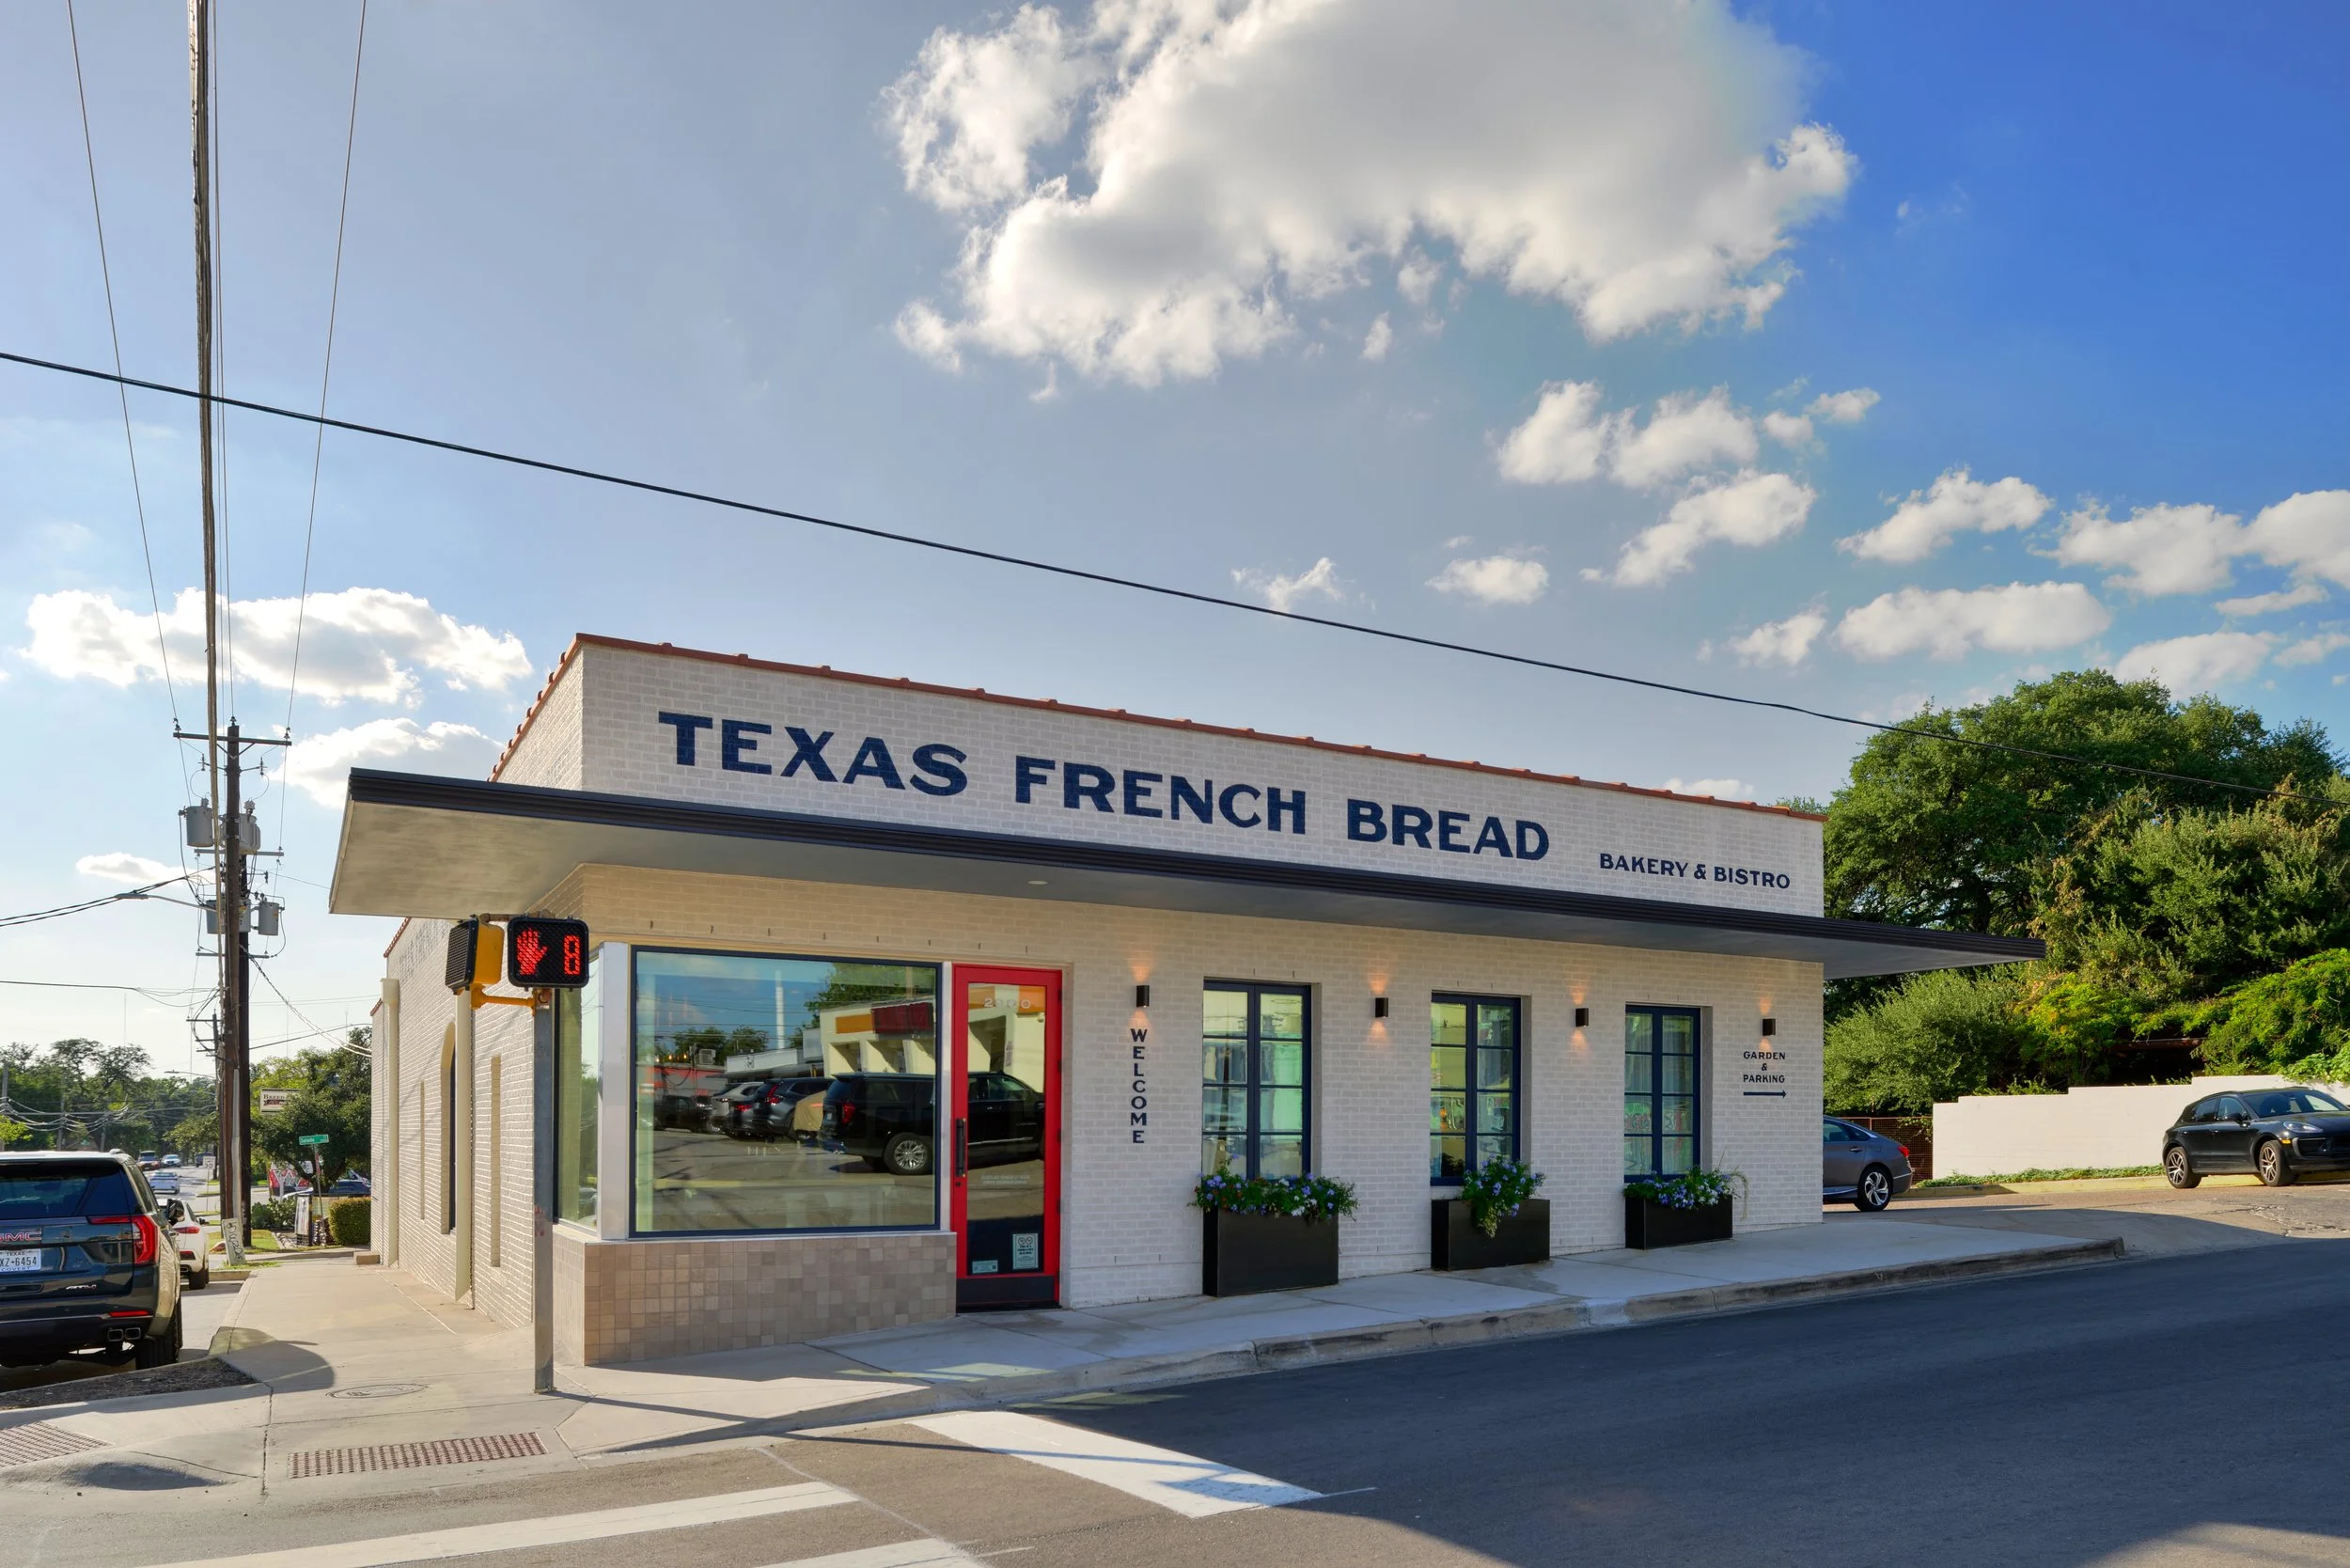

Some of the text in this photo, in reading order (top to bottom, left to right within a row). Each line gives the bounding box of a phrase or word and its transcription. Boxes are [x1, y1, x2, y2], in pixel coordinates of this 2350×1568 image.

[658, 711, 1550, 861] TEXAS FRENCH BREAD
[1599, 853, 1791, 889] BAKERY & BISTRO
[564, 934, 581, 976] 8
[1743, 1051, 1786, 1060] GARDEN
[1761, 1062, 1768, 1072] &
[1130, 1027, 1148, 1144] WELCOME
[1743, 1074, 1786, 1084] PARKING
